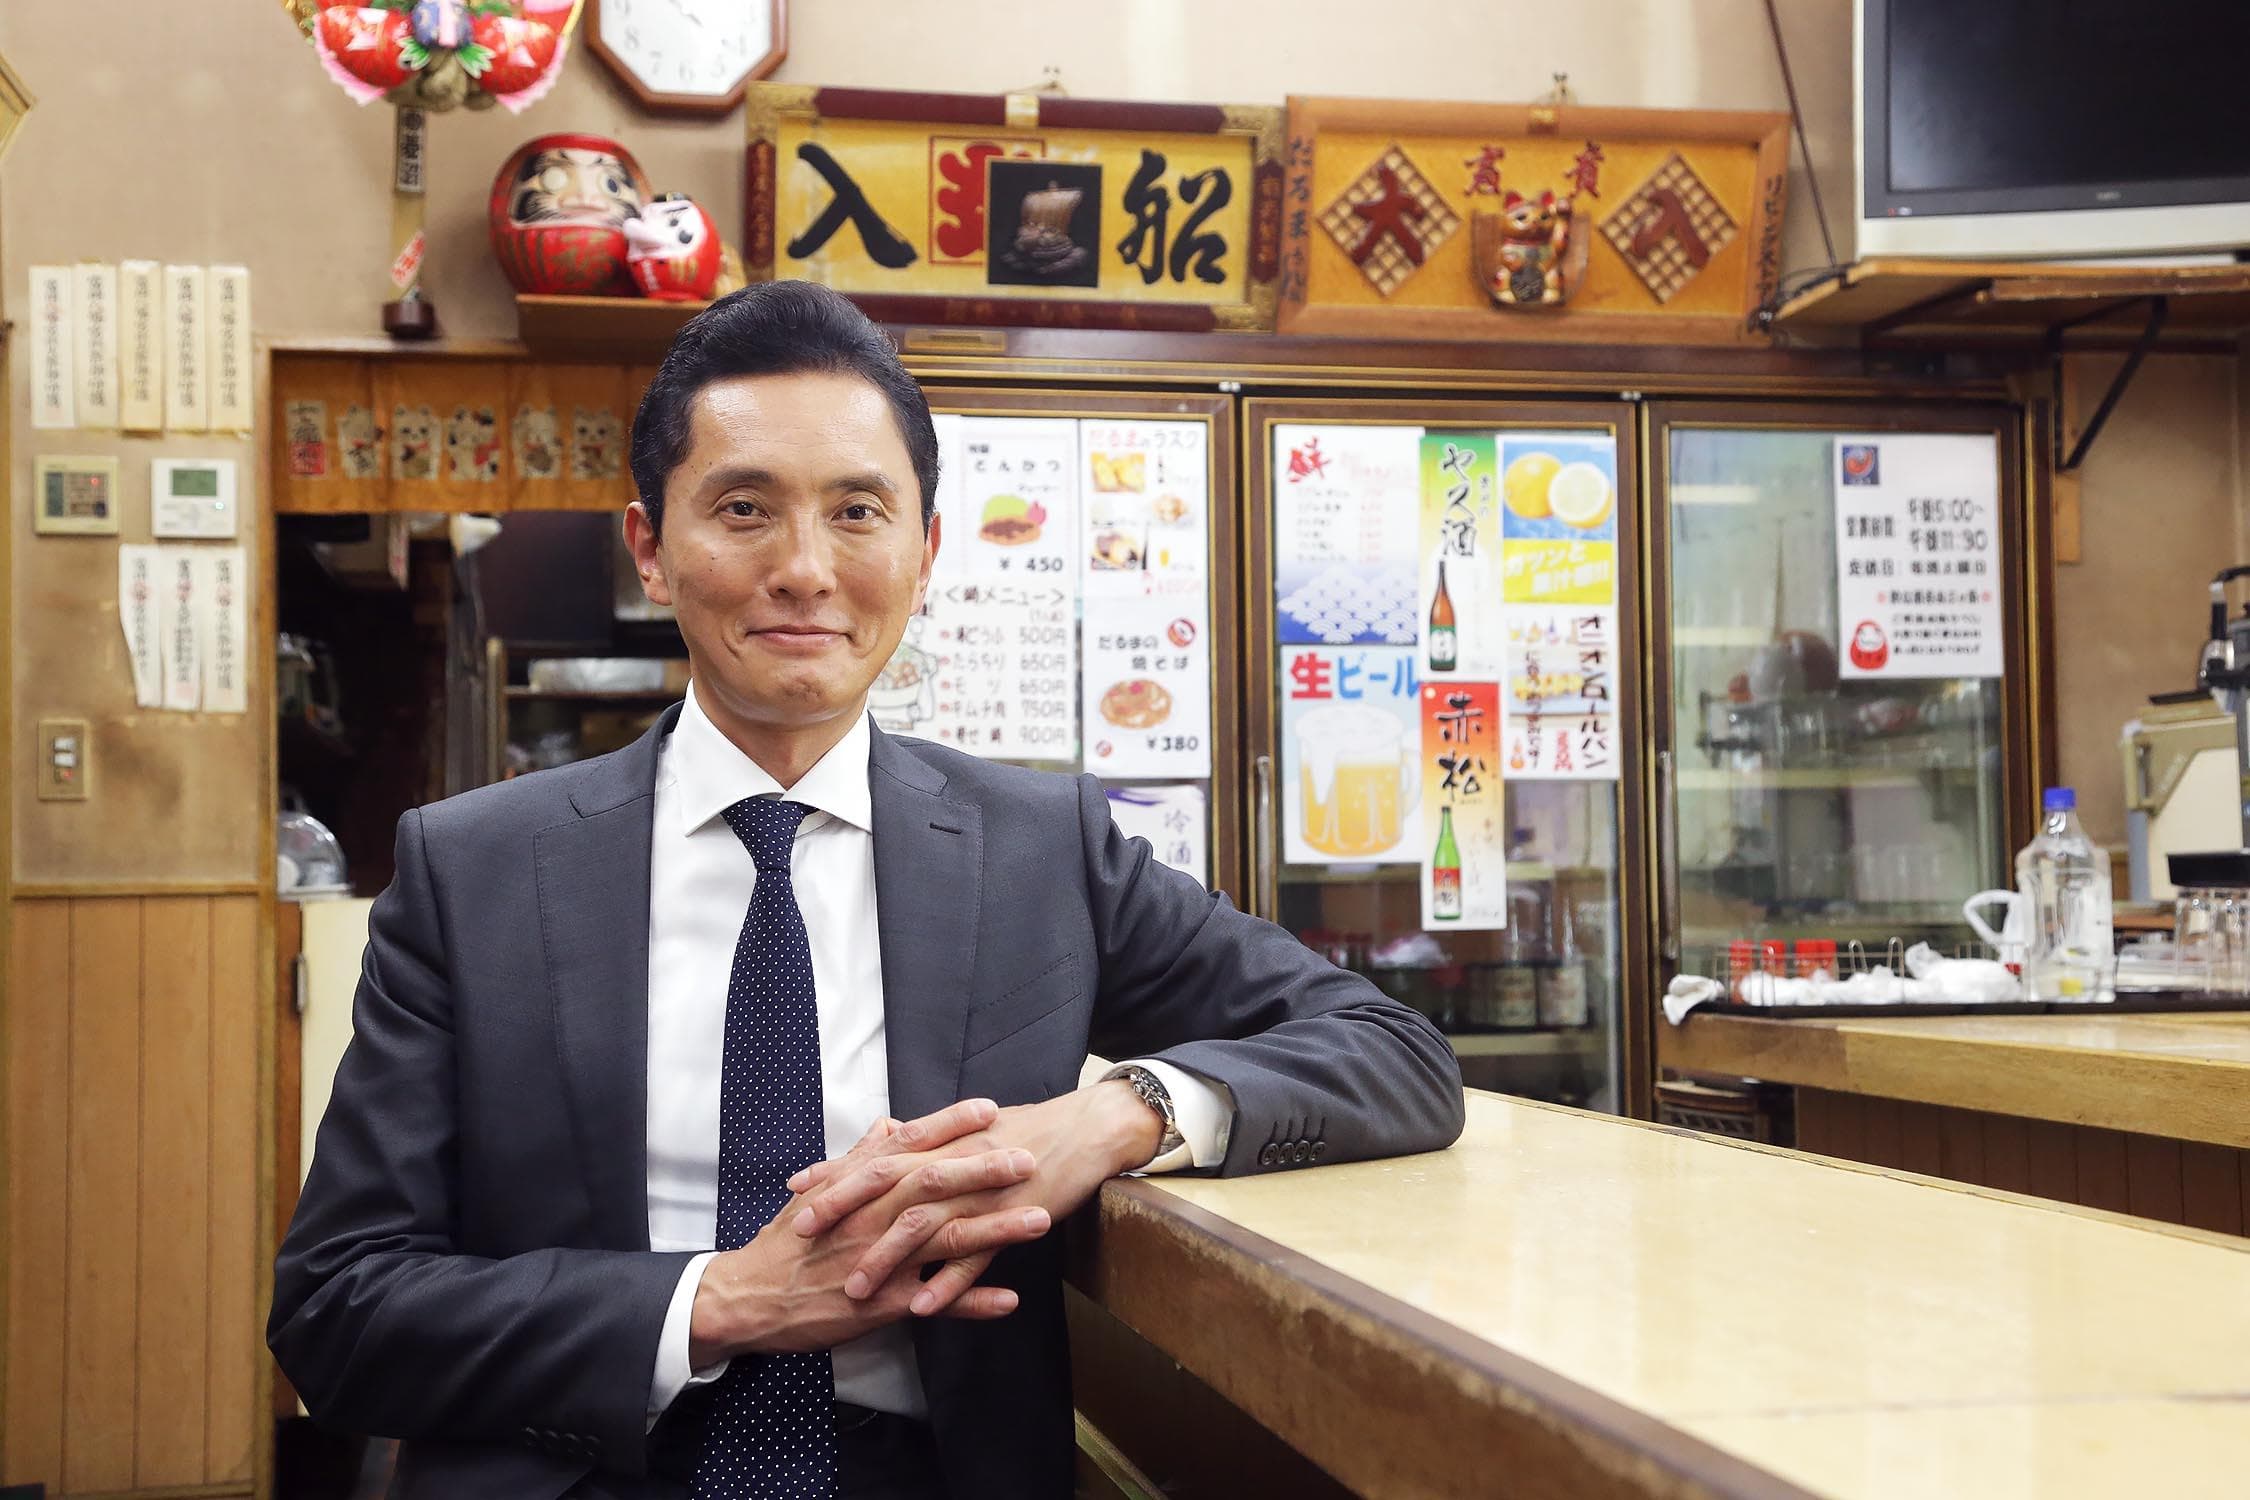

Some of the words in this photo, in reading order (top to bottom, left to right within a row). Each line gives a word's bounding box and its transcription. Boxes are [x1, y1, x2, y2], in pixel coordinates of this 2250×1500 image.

[787, 142, 918, 269] 入
[1117, 148, 1232, 285] 船
[1026, 556, 1063, 572] 450
[1098, 635, 1160, 650] だるまの
[1290, 652, 1421, 700] 生ビール
[1433, 691, 1485, 803] 赤松
